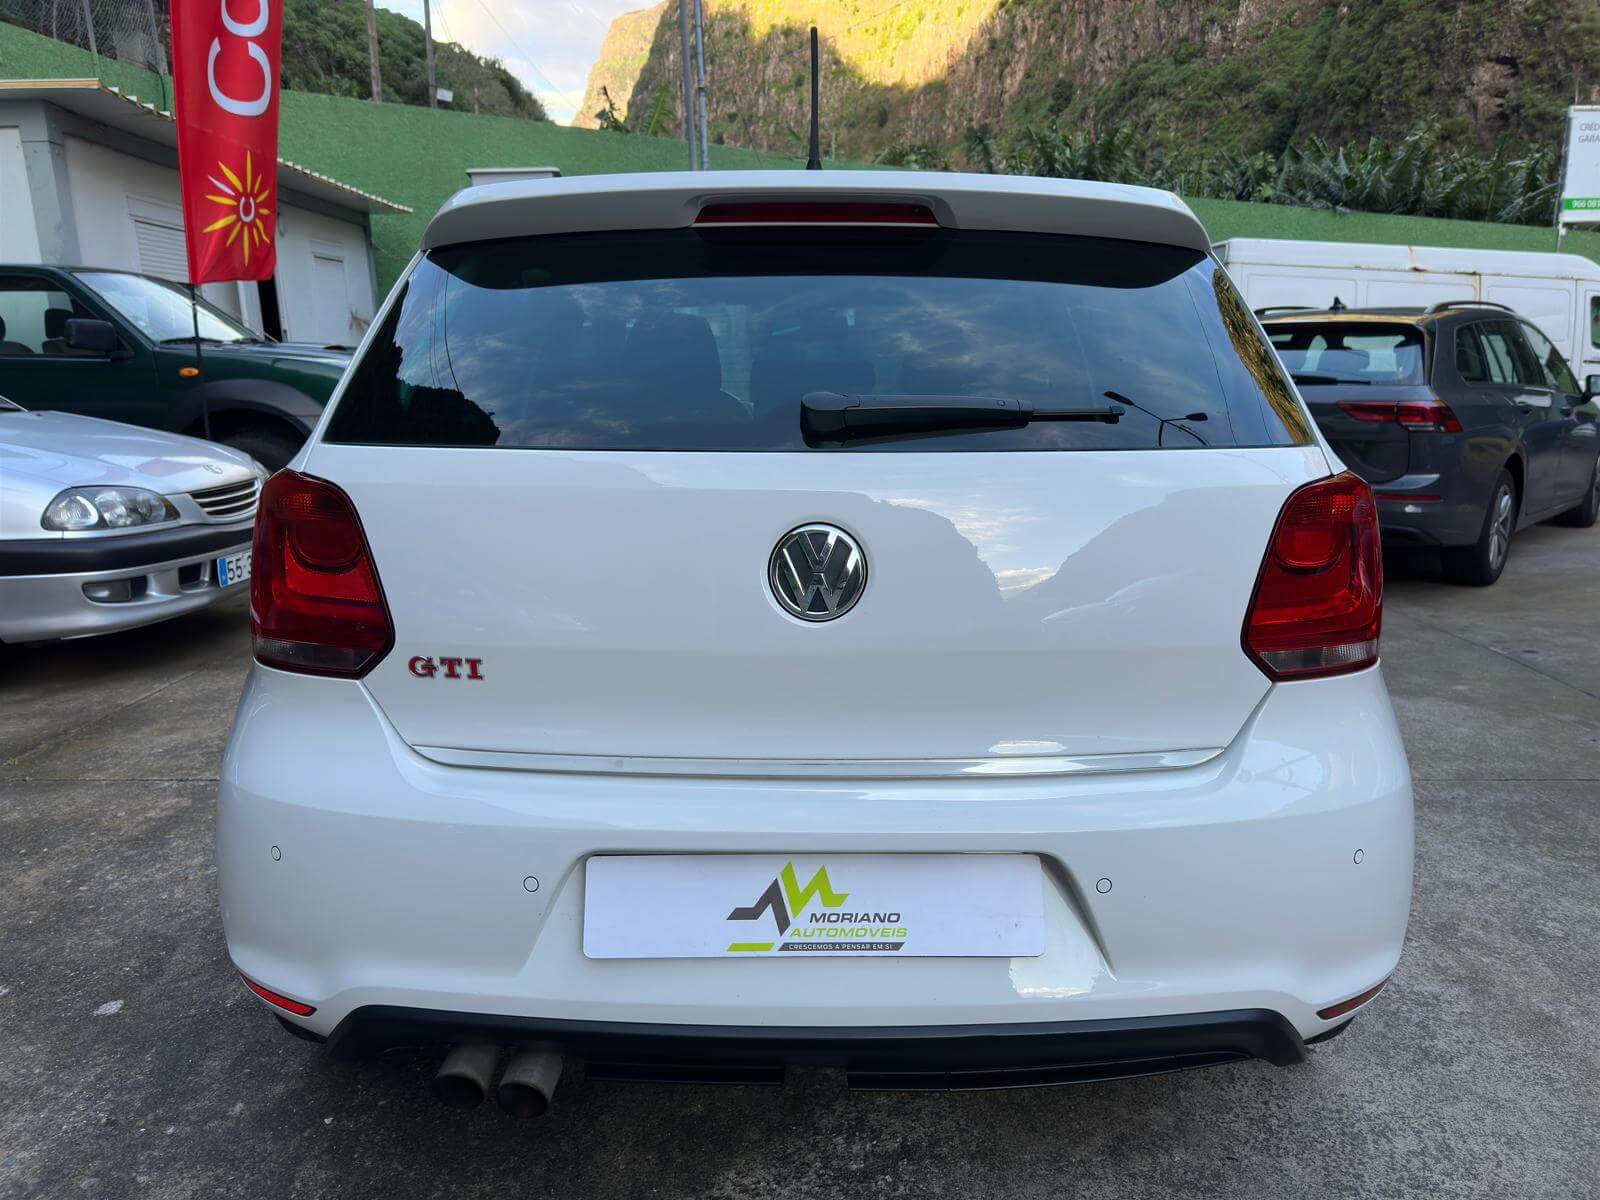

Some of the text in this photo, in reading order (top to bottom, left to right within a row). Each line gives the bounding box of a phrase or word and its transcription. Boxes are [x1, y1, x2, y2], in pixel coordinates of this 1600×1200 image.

[408, 655, 484, 680] GTI
[809, 912, 901, 923] MORIANO
[790, 925, 908, 938] AUTOMÓVEIS
